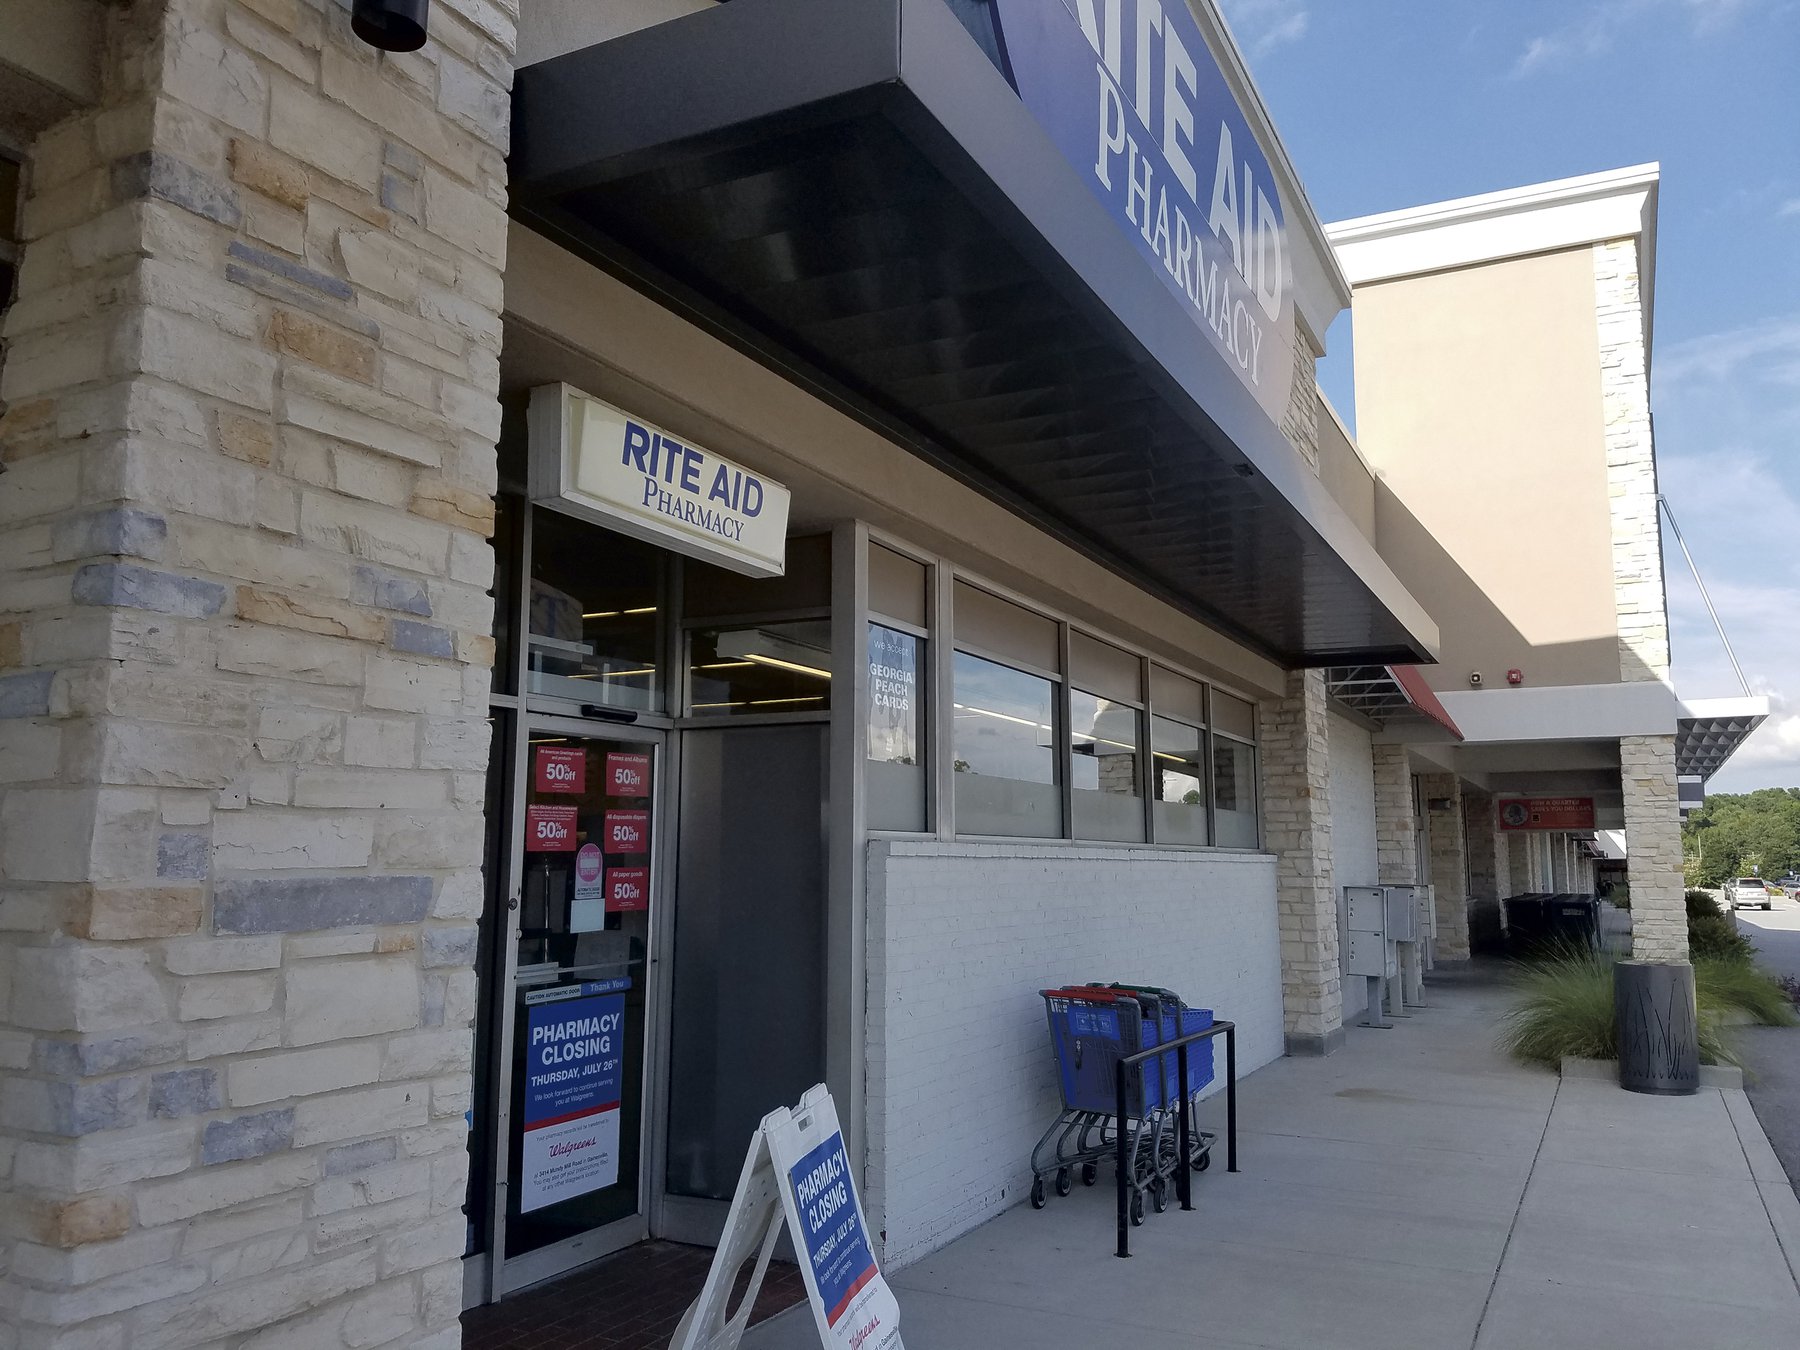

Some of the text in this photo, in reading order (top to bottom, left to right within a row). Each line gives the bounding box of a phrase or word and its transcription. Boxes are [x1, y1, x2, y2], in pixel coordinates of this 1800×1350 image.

[1077, 0, 1282, 323] ITE AID
[1095, 62, 1264, 387] PHARMACY
[622, 421, 764, 518] RITE AID
[642, 476, 745, 542] PHARMACY
[870, 662, 912, 684] GEORGIA
[875, 678, 908, 697] PEACH
[875, 693, 909, 711] CARDS
[564, 771, 577, 781] off
[631, 776, 641, 785] off
[555, 829, 567, 839] off
[629, 832, 639, 841] off
[629, 889, 640, 899] off
[527, 993, 545, 1001] CAUTION
[545, 989, 568, 998] AUTOMATIC
[590, 980, 624, 992] Thank You
[533, 1013, 620, 1046] PHARMACY
[541, 1035, 610, 1065] CLOSING
[531, 1067, 580, 1087] THURSDAY,
[582, 1062, 602, 1076] JULY
[534, 1094, 543, 1102] We
[543, 1091, 553, 1100] look
[554, 1087, 573, 1098] forward
[579, 1081, 597, 1092] continue
[598, 1078, 614, 1087] serving
[555, 1099, 564, 1107] you
[548, 1136, 597, 1158] Walgreens
[539, 1168, 549, 1178] 3414
[550, 1164, 564, 1174] Mundy
[564, 1161, 572, 1169] Mill
[572, 1158, 583, 1168] Road
[797, 1148, 845, 1210] PHARMACY
[808, 1180, 848, 1234] CLOSING
[813, 1232, 838, 1270] THURSDAY,
[836, 1219, 849, 1243] JULY
